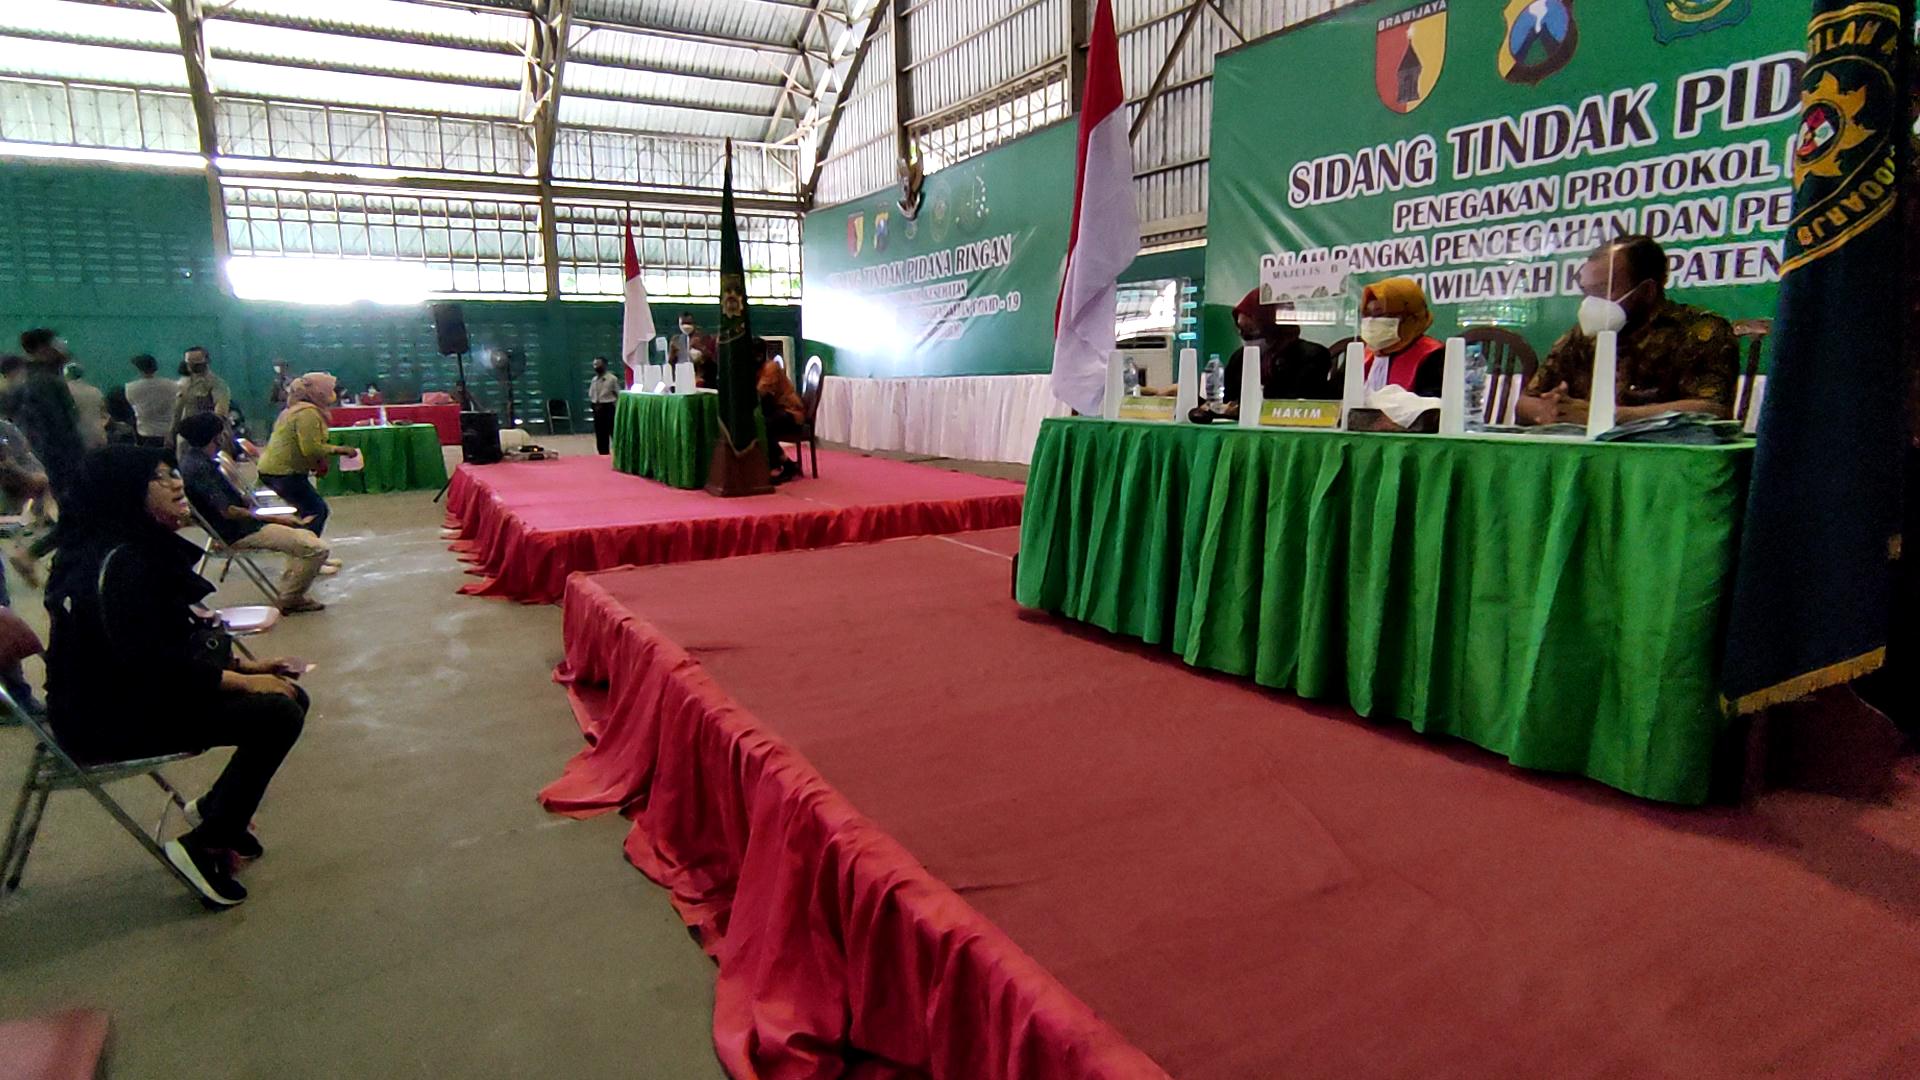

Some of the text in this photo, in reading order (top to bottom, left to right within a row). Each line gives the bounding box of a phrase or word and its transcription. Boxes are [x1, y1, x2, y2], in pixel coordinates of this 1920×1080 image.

[1377, 0, 1447, 32] BRAWIJAYA
[1289, 138, 1433, 204] SIDANG
[1450, 87, 1653, 175] TINDAK
[1395, 174, 1557, 229] PENEGAKAN
[1567, 145, 1774, 205] PROTOKOL
[1434, 212, 1632, 262] PENCEGAHAN
[1645, 197, 1723, 239] DAN
[906, 250, 953, 283] PIDANA
[955, 235, 1012, 273] RINGAN
[1007, 293, 1020, 311] 19
[1432, 265, 1553, 300] WILAYAH
[1271, 407, 1322, 419] HAKIM
